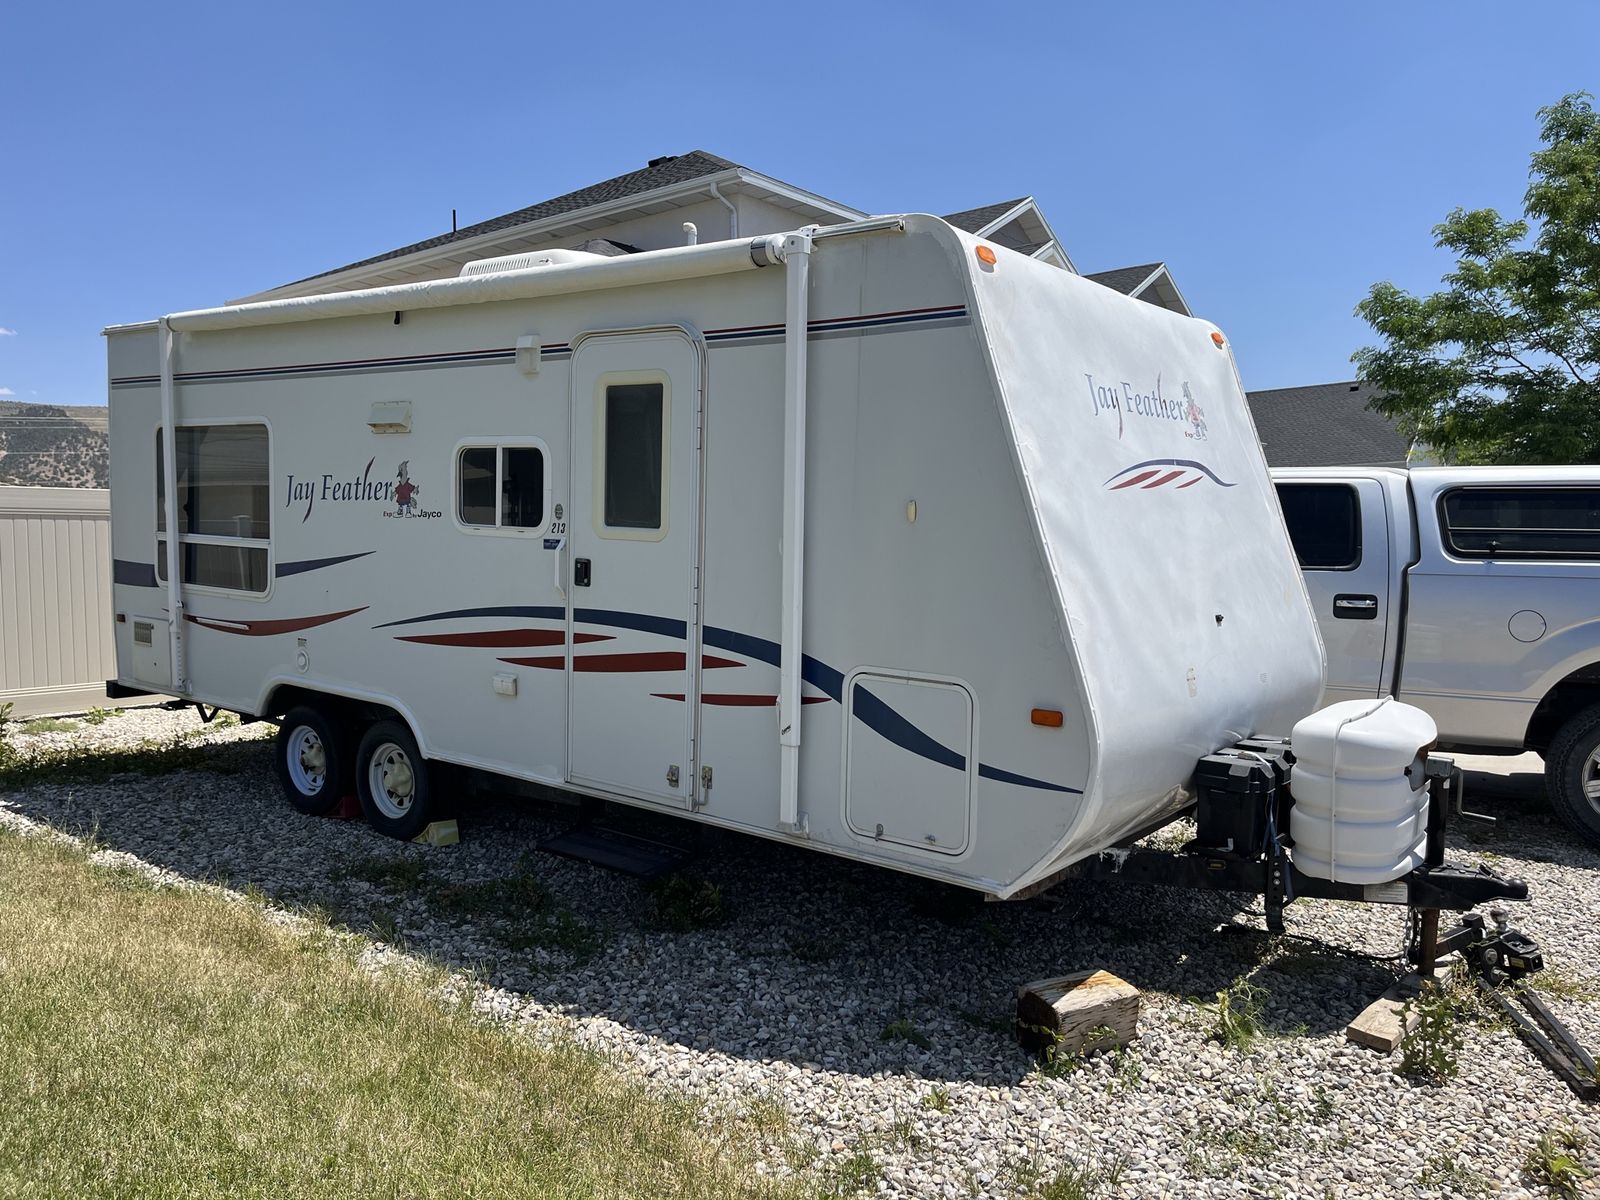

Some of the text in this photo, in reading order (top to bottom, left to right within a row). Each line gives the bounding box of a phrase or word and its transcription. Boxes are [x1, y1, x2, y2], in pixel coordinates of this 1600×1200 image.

[1084, 370, 1184, 440] Jay Feather
[286, 455, 393, 524] Jay Feather
[417, 509, 442, 519] Jayco
[551, 522, 566, 534] 213
